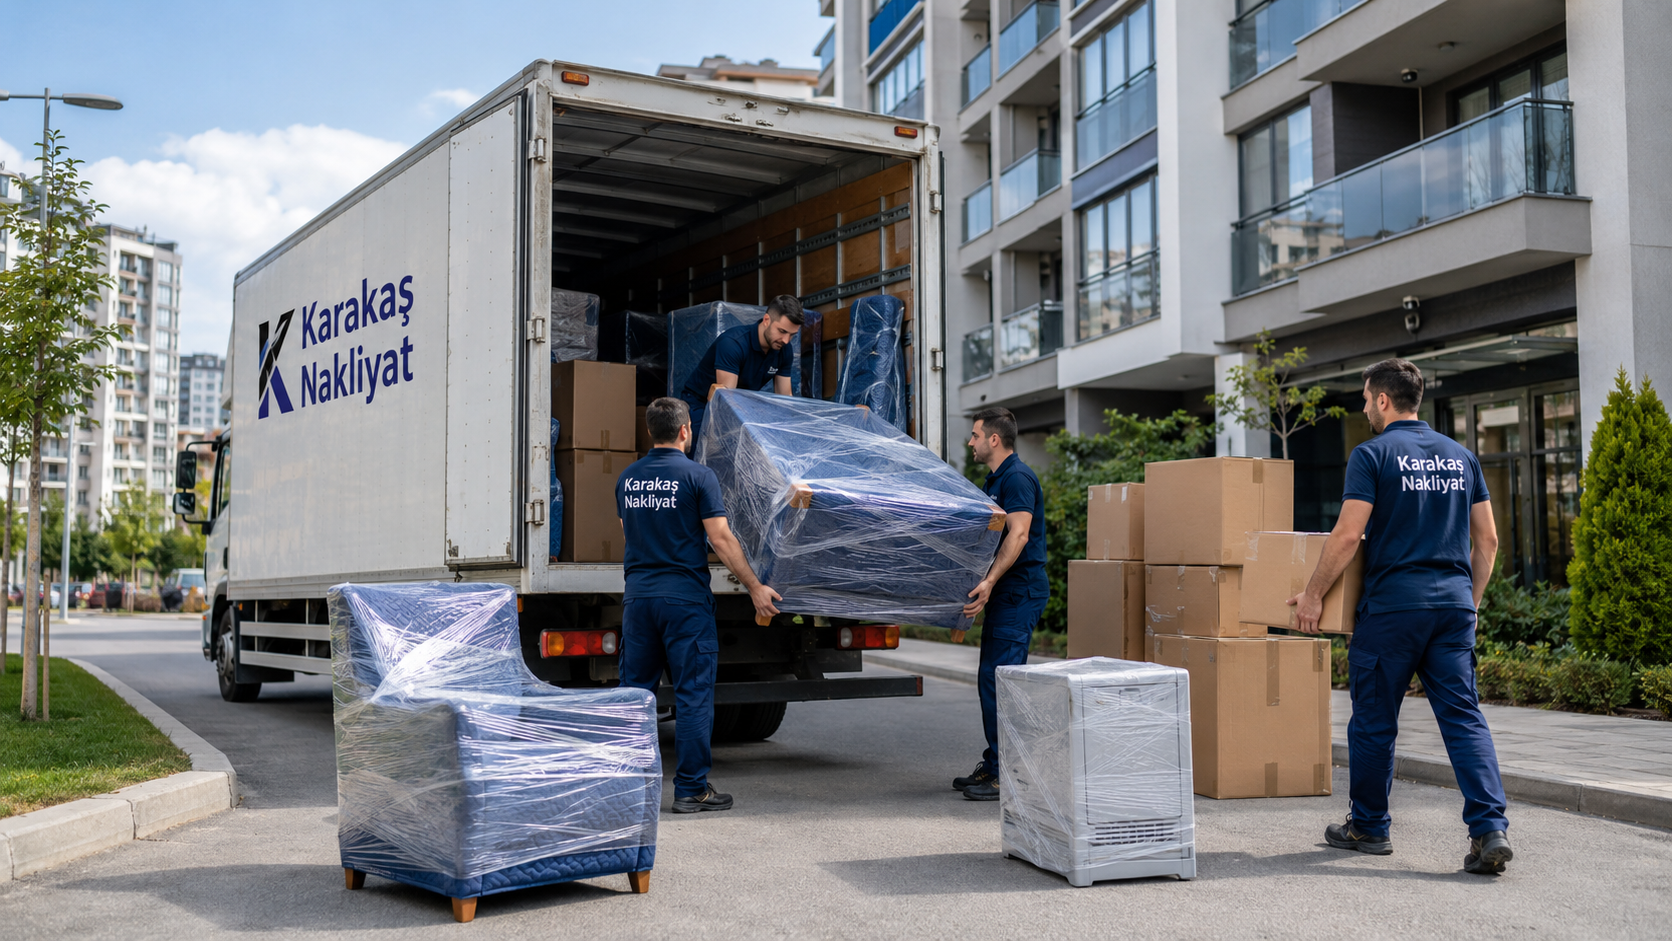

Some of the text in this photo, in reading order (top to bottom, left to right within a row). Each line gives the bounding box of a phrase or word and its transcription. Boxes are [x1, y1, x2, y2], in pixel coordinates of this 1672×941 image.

[302, 275, 414, 350] Karakaş
[301, 335, 414, 408] Nakliyat
[1397, 454, 1464, 475] Karakaş
[624, 477, 679, 494] Karakaş
[1401, 475, 1465, 494] Nakliyat
[624, 494, 677, 511] Nakliyat
